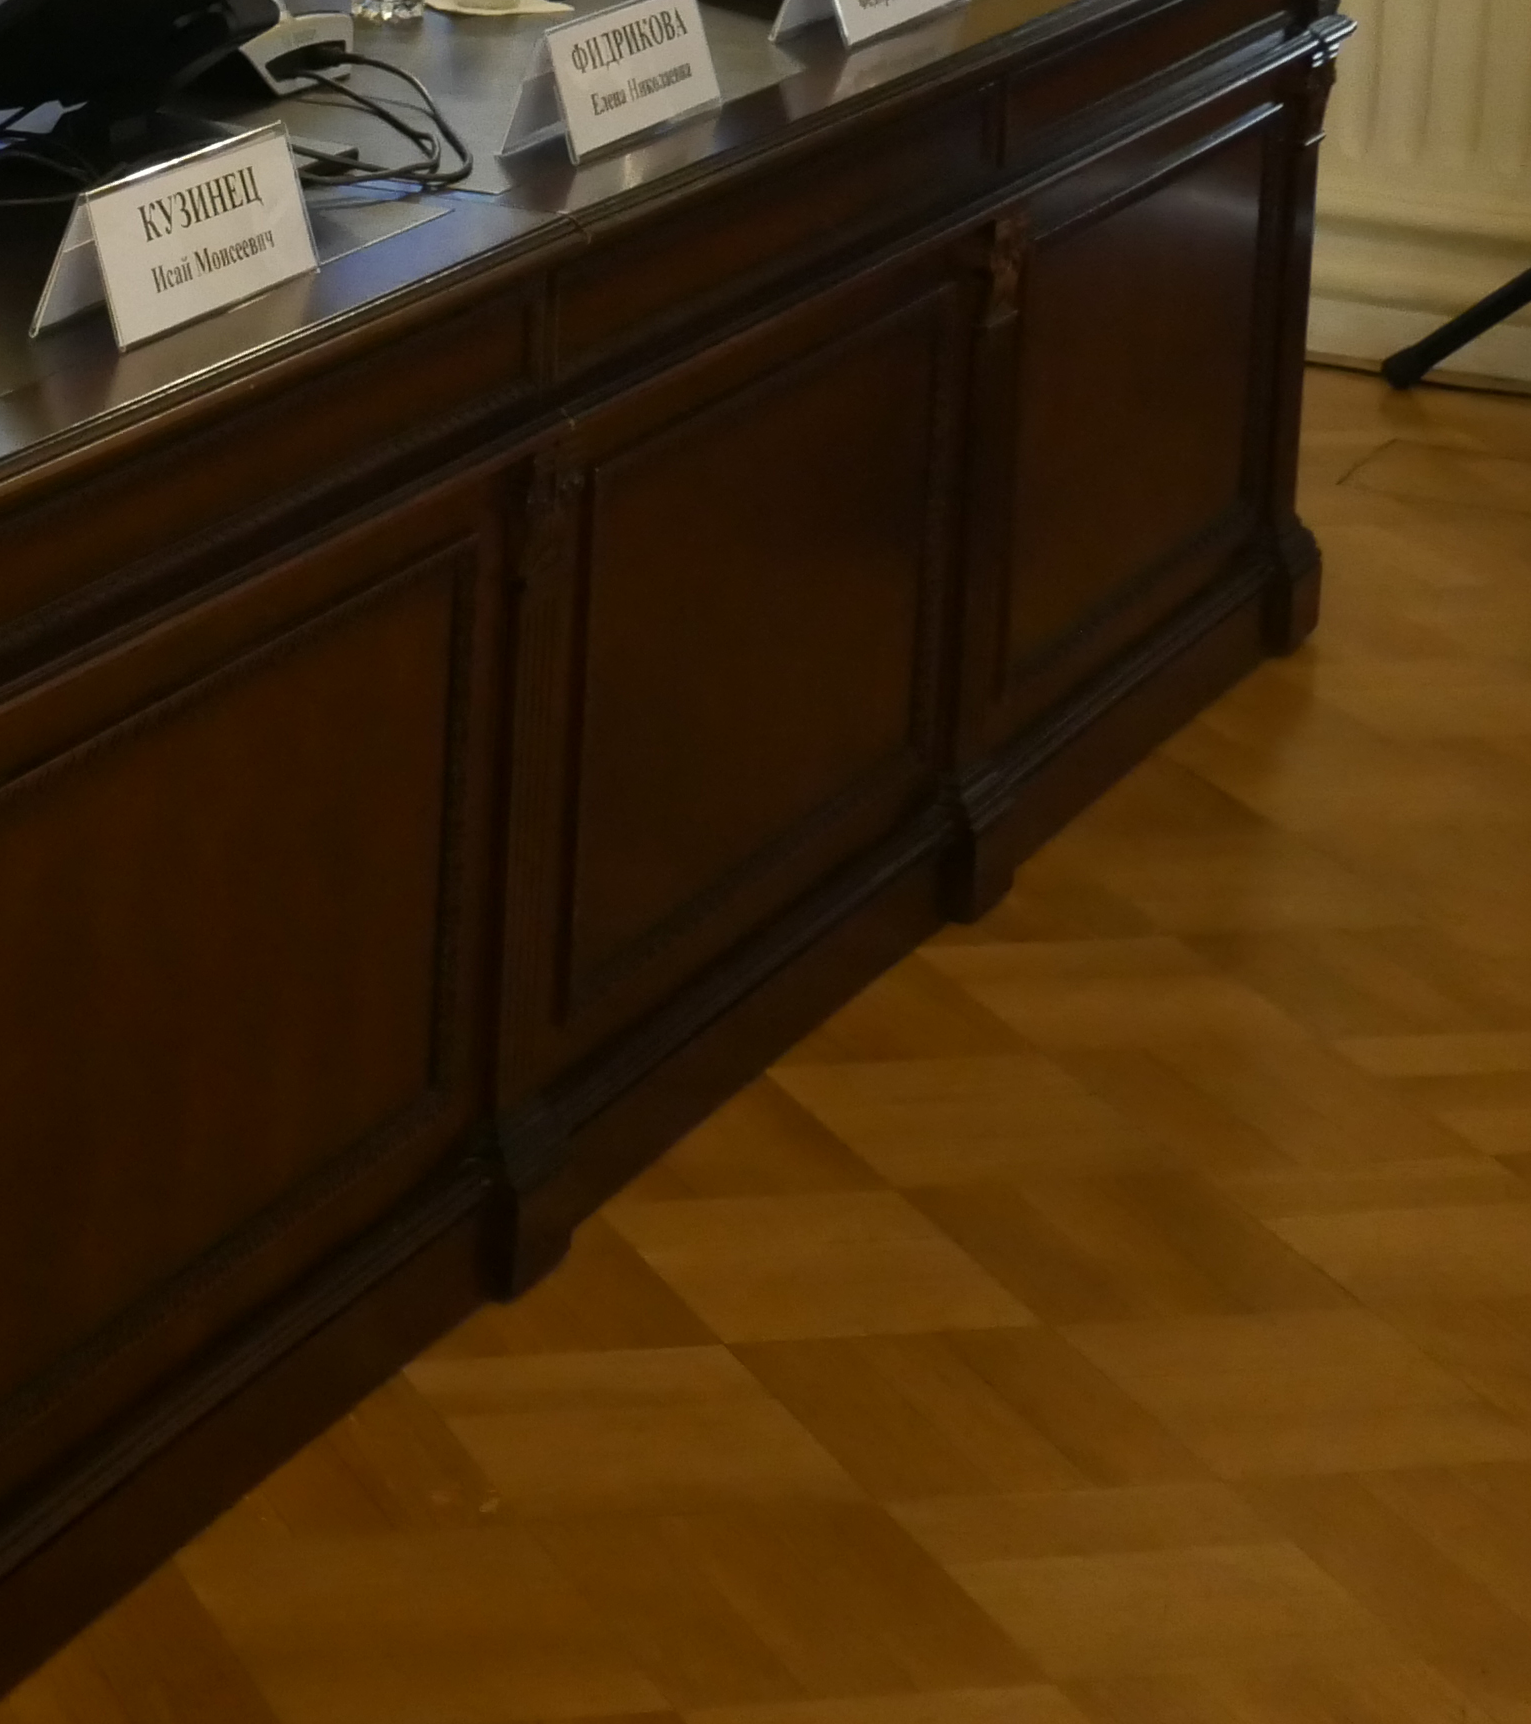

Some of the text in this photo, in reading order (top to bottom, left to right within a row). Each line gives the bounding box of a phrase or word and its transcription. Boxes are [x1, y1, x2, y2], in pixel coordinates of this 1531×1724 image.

[571, 7, 688, 74] ФИДРИКОВА
[137, 165, 264, 243] КУЗИНЕЦ
[151, 230, 276, 294] Исай Моисеевич
